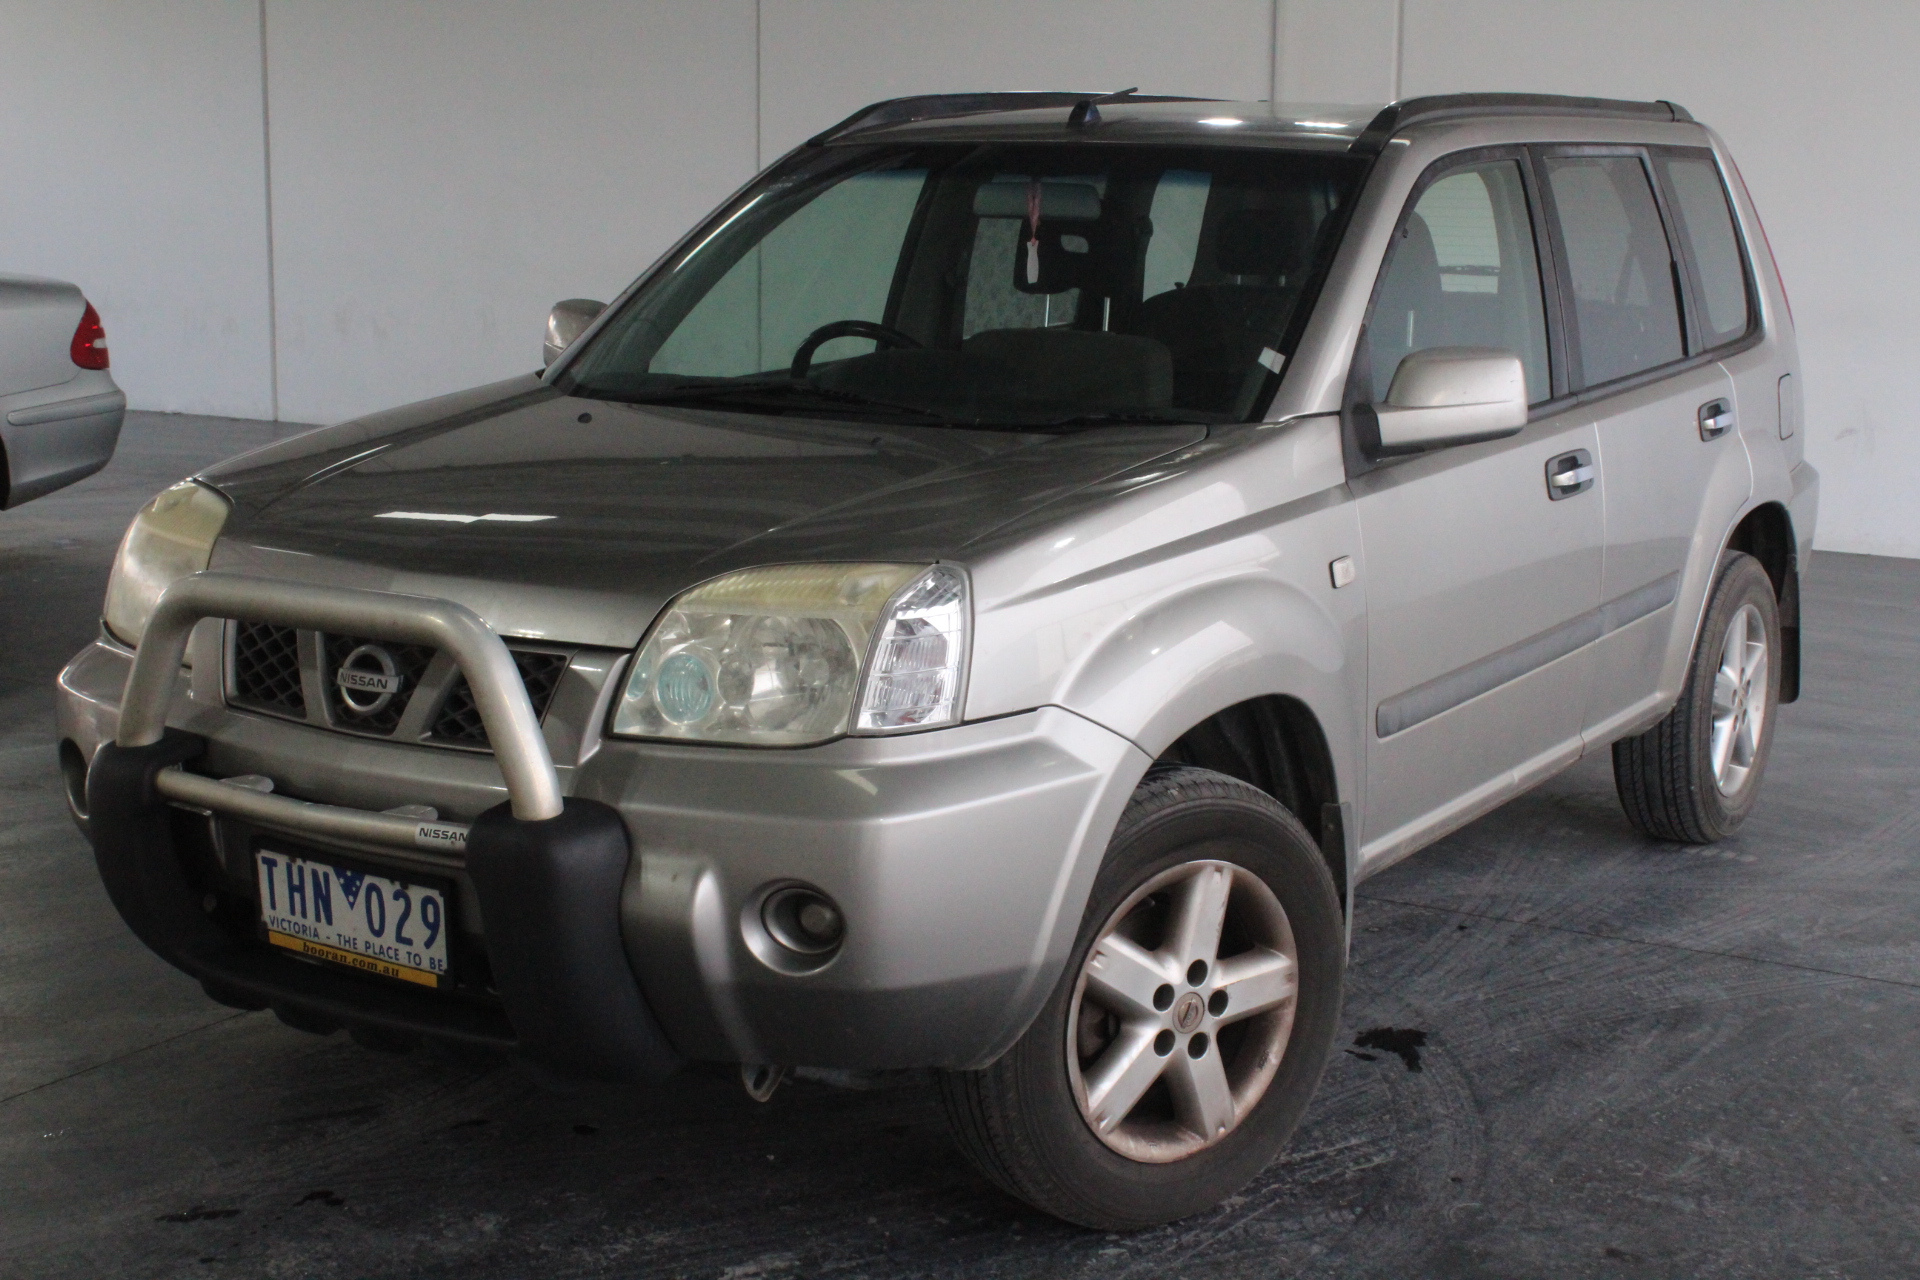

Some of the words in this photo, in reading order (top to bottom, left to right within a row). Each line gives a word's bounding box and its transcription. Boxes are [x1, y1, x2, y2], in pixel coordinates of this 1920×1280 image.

[340, 672, 388, 689] NISSAN
[419, 827, 468, 842] NISSAN
[261, 856, 333, 926] THN
[365, 882, 441, 950] 029
[269, 915, 320, 940] VICTORIA
[336, 934, 358, 950] THE
[365, 941, 400, 961] PLACE
[406, 951, 422, 967] TO
[429, 957, 444, 972] BE
[303, 942, 400, 977] booran.com.au
